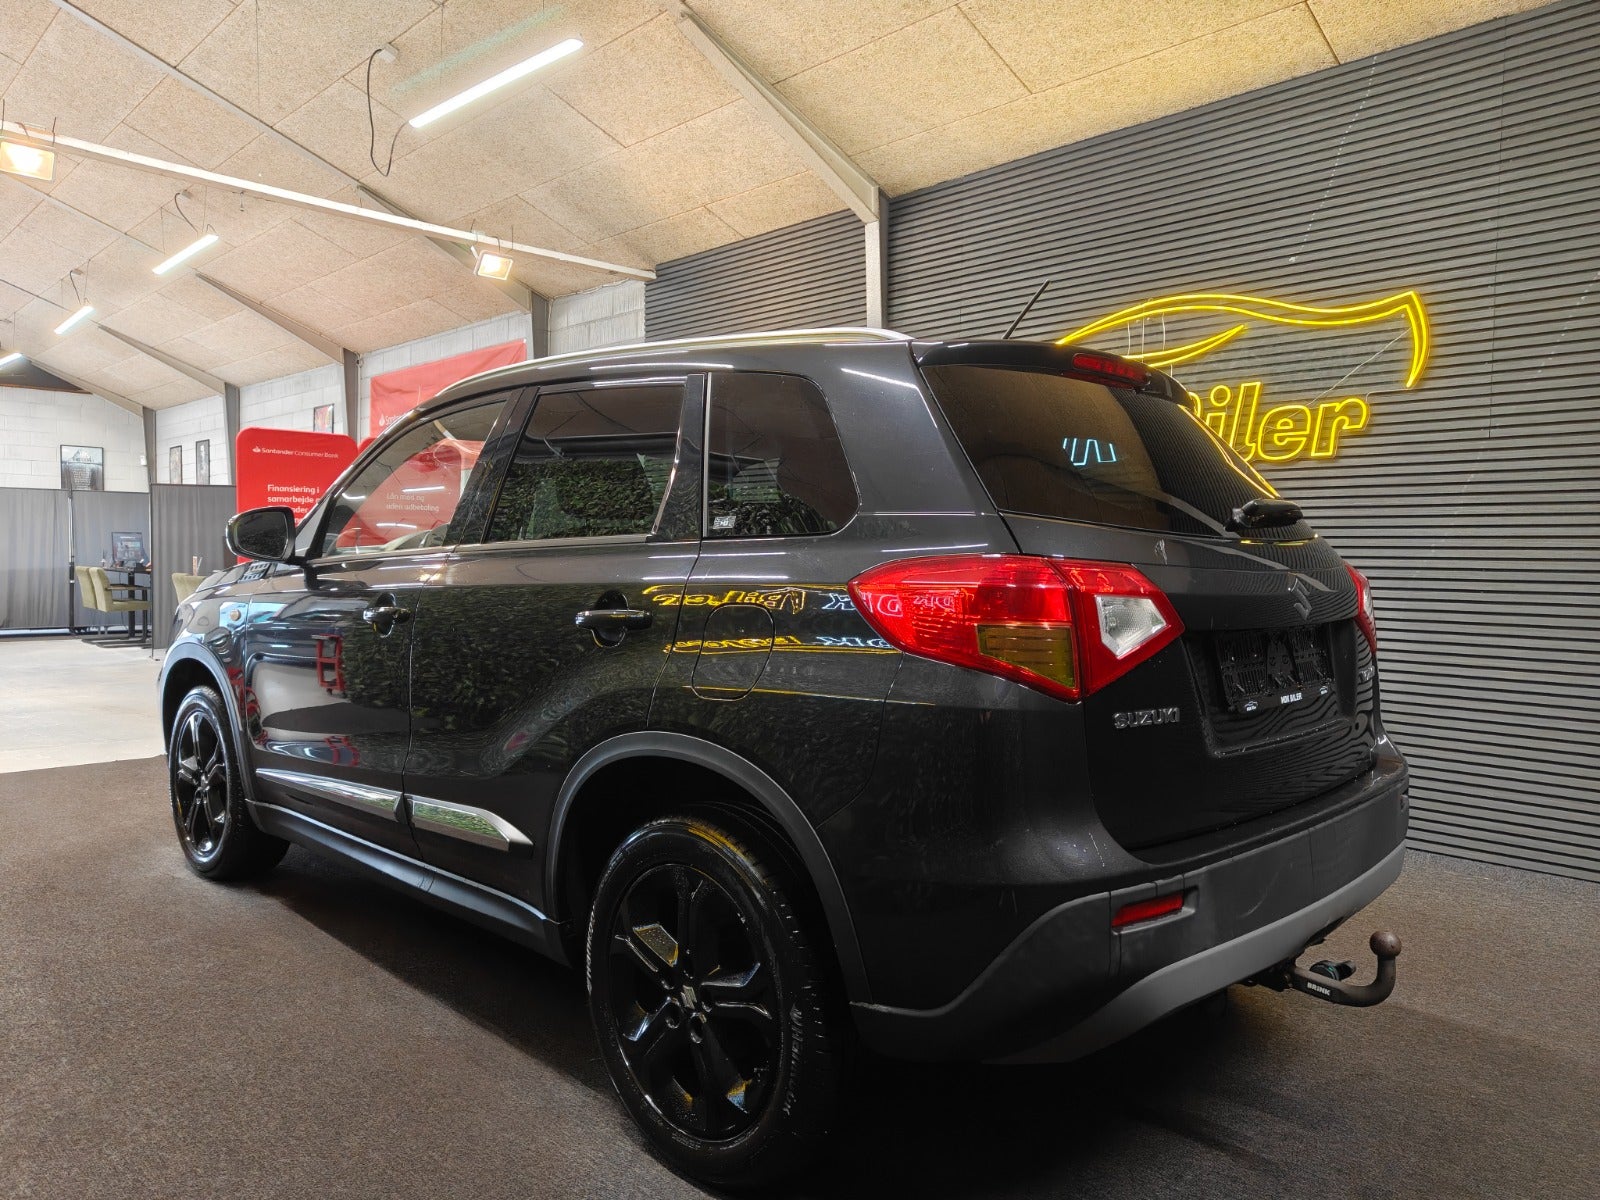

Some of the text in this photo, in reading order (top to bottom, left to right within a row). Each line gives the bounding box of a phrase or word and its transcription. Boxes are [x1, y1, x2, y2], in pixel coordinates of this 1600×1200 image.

[1188, 381, 1368, 461] iler
[261, 447, 294, 456] Santander
[294, 449, 324, 458] Consumer
[267, 484, 316, 495] Finansiering
[267, 495, 314, 505] samarbejde
[1112, 707, 1181, 729] SUZUKI
[1307, 982, 1330, 996] BRINK
